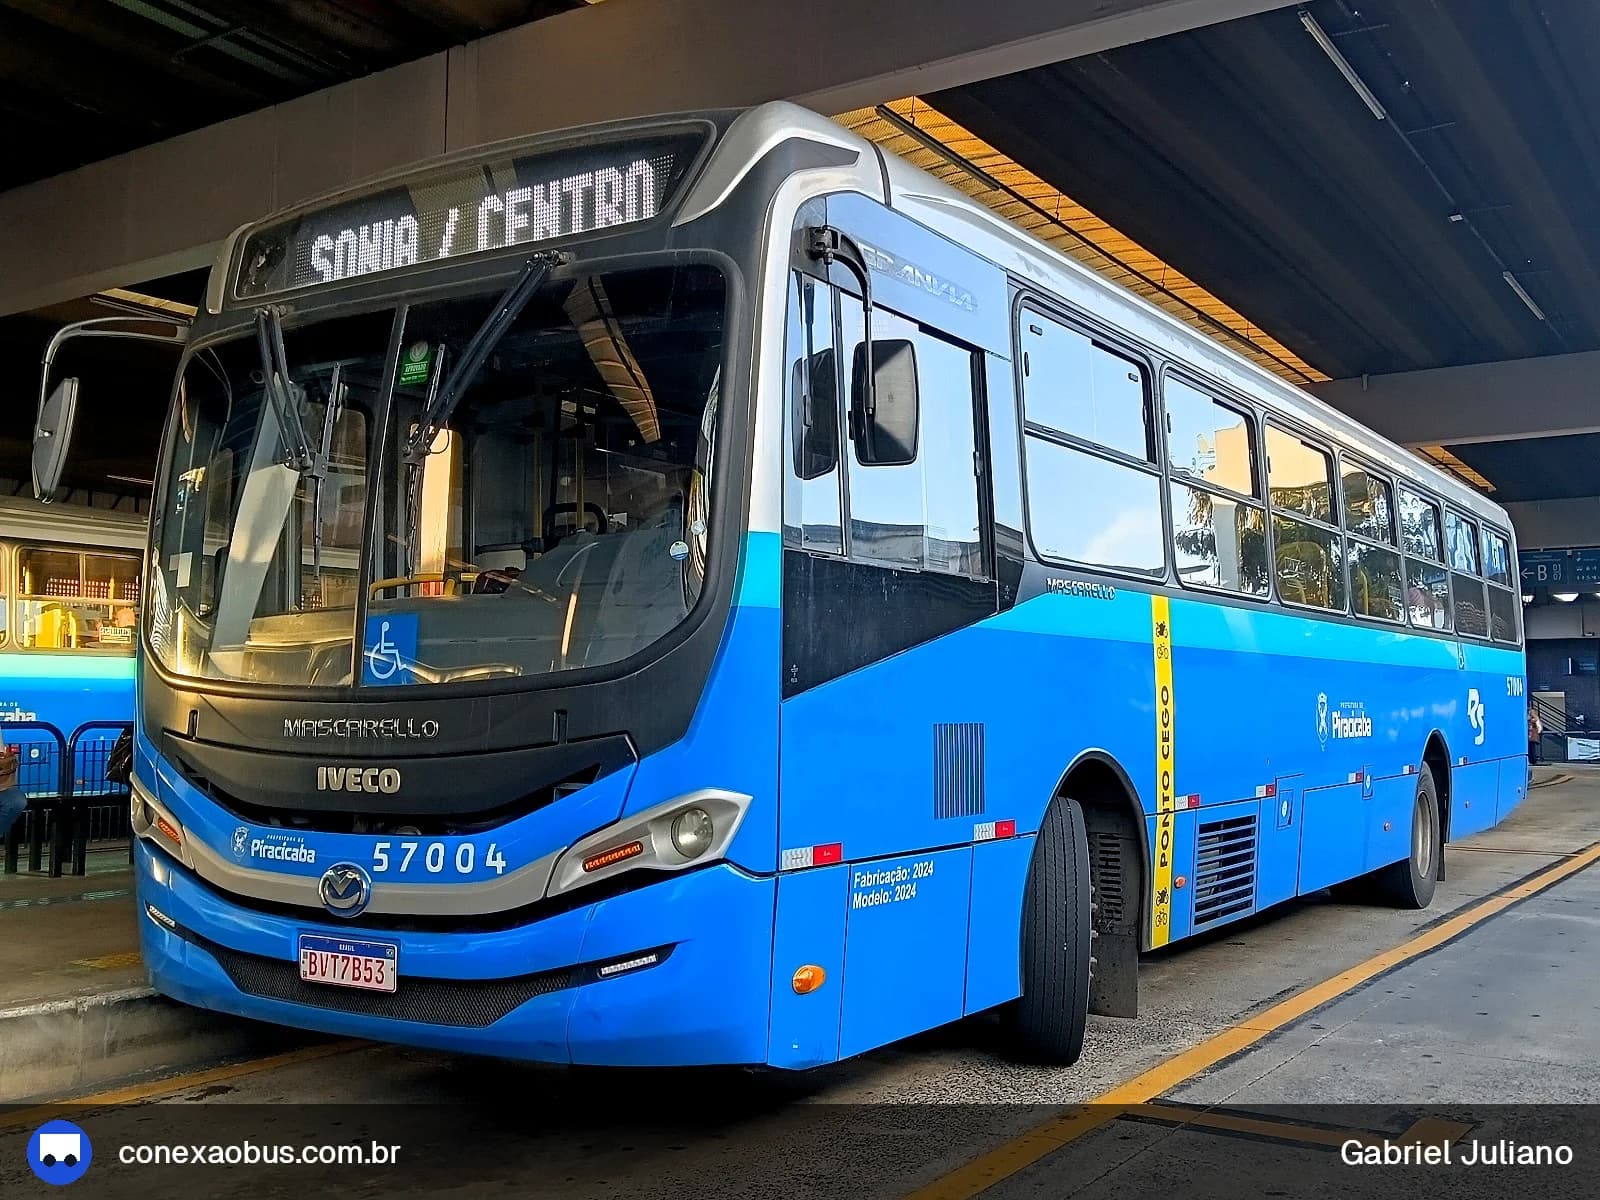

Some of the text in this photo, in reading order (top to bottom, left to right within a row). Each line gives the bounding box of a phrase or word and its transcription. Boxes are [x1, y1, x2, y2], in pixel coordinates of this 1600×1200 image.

[311, 214, 418, 282] SONIA
[477, 158, 656, 251] CENTRO
[1537, 564, 1548, 581] B
[1046, 578, 1116, 600] MASCARELLO
[283, 718, 439, 738] MASCARELLO
[1332, 710, 1372, 738] Piracicaba
[317, 767, 401, 793] IVECO
[1159, 685, 1170, 868] PONTO CEGO
[251, 839, 316, 863] Piracicaba
[373, 842, 506, 875] 57004
[853, 860, 934, 888] Fabricação: 2024
[852, 882, 917, 910] Modelo: 2024
[308, 952, 385, 985] BVT7B53
